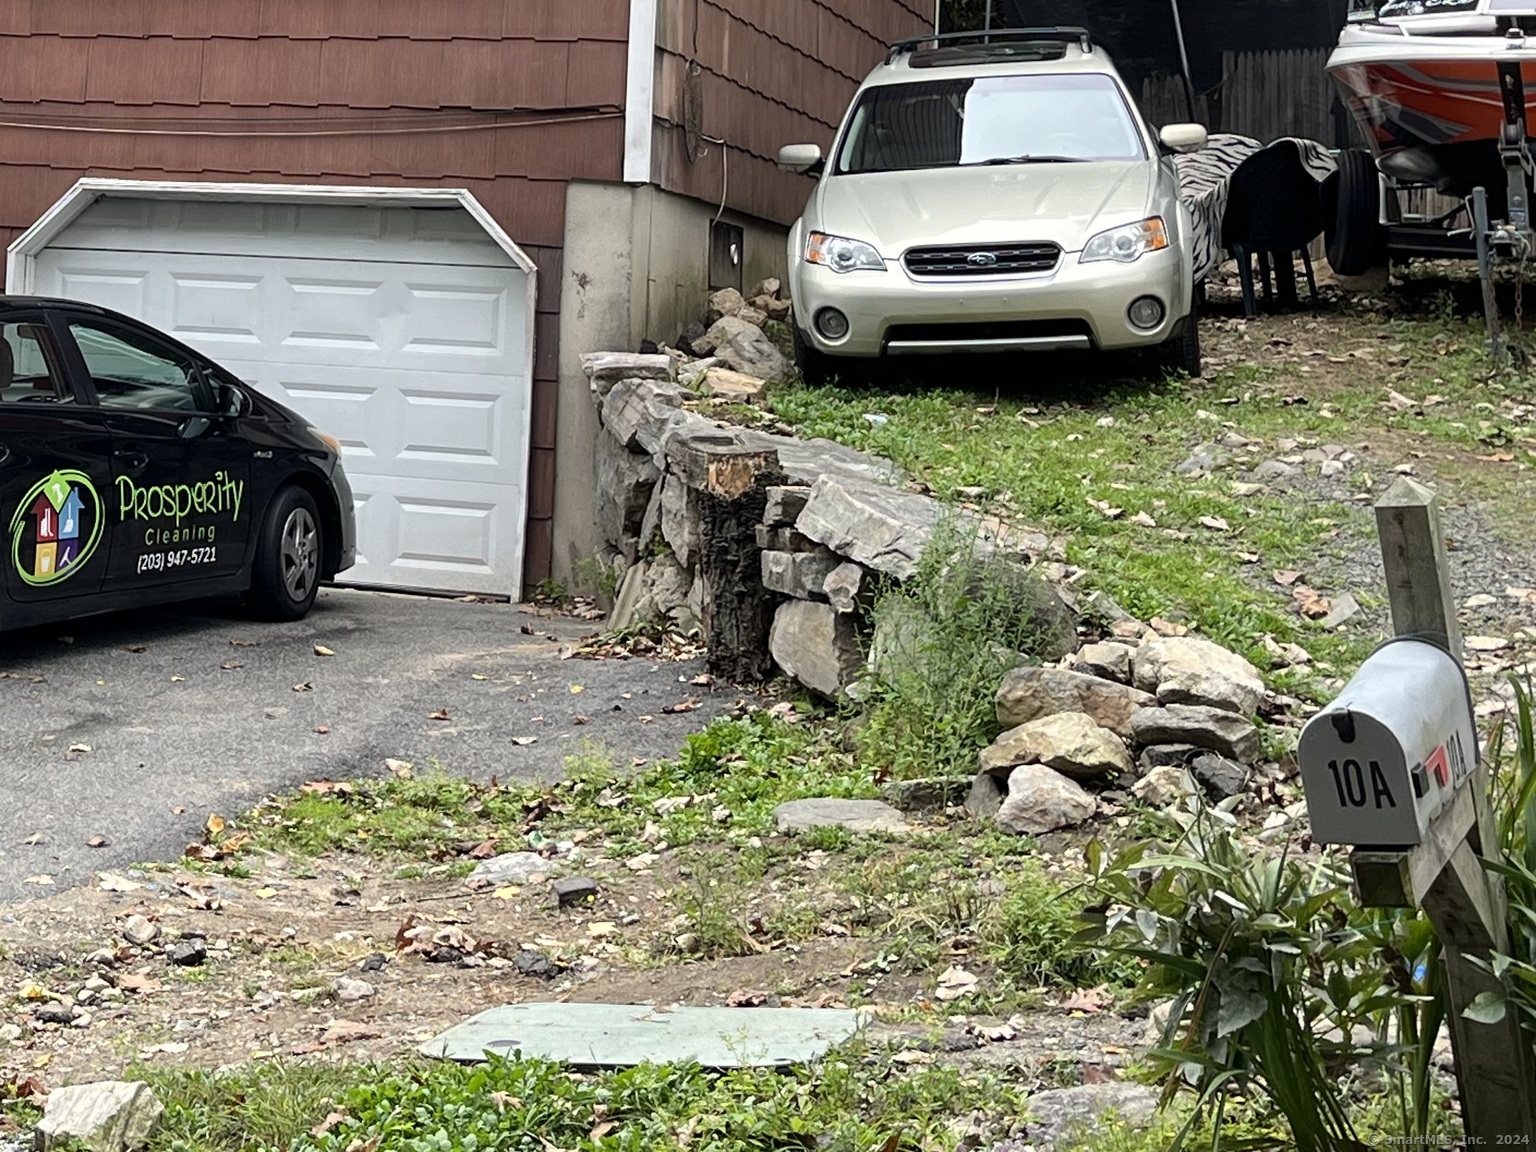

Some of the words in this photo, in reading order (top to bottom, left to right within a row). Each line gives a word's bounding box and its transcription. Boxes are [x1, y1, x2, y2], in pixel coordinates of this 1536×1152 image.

[144, 524, 216, 546] Cleaning
[136, 552, 165, 574] (203)
[166, 546, 217, 568] 947-5721
[1327, 758, 1397, 809] 10A
